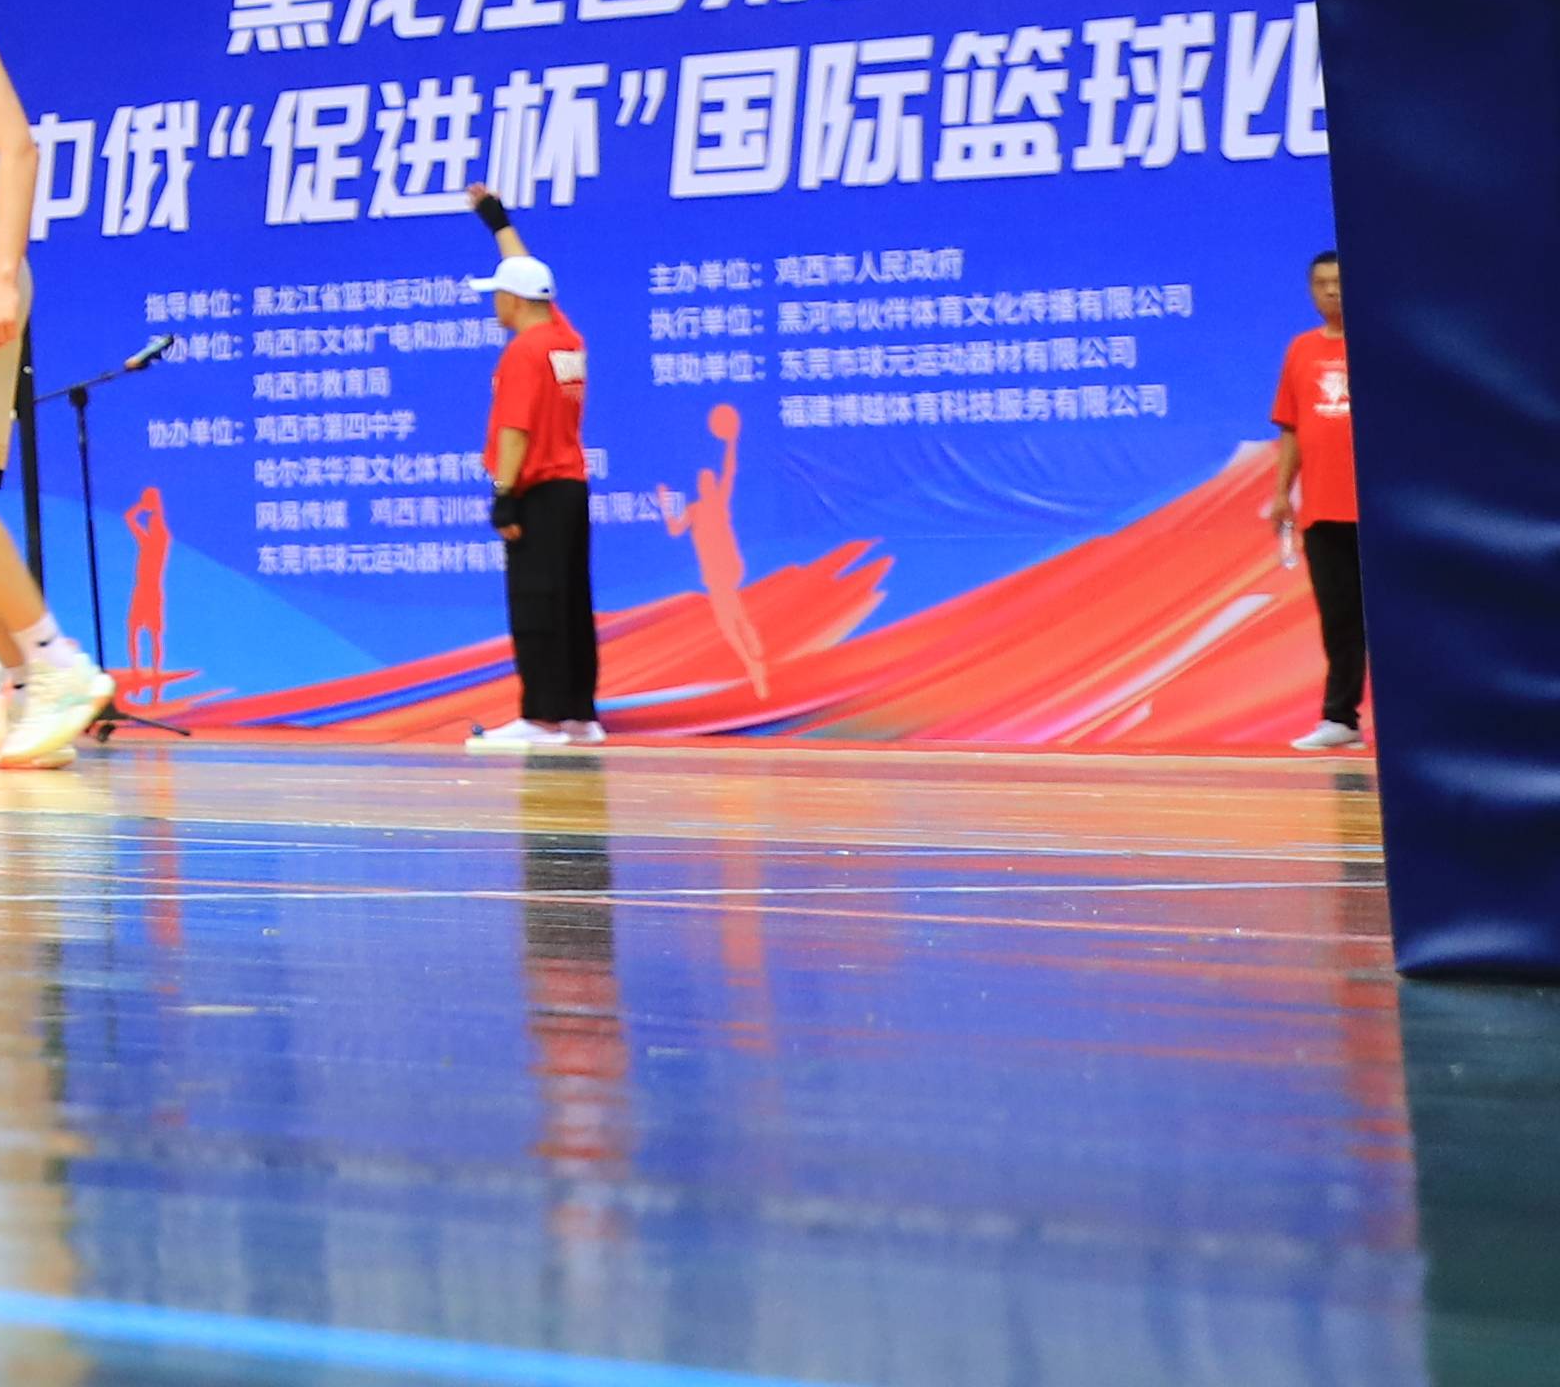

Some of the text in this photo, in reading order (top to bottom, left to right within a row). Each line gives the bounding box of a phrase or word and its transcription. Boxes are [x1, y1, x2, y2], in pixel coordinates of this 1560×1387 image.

[28, 0, 1329, 242] 中俄“促进杯”国际篮球比
[774, 246, 965, 289] 鸡西市人民政府
[251, 274, 484, 318] 黑龙江省篮球运动协会
[777, 282, 1194, 336] 黑河市伙伴体育文化传播有限公司
[146, 316, 510, 364] 办单位： 鸡西市文体广电和旅游局
[778, 334, 1138, 383] 东莞市球元运动器材有限公司
[251, 366, 392, 402] 鸡西市教育局
[253, 410, 416, 445] 鸡西市第四中学
[253, 447, 609, 489] 哈尔滨华澳文化体育传司
[255, 491, 687, 531] 网易传媒 鸡西青训体有限公司
